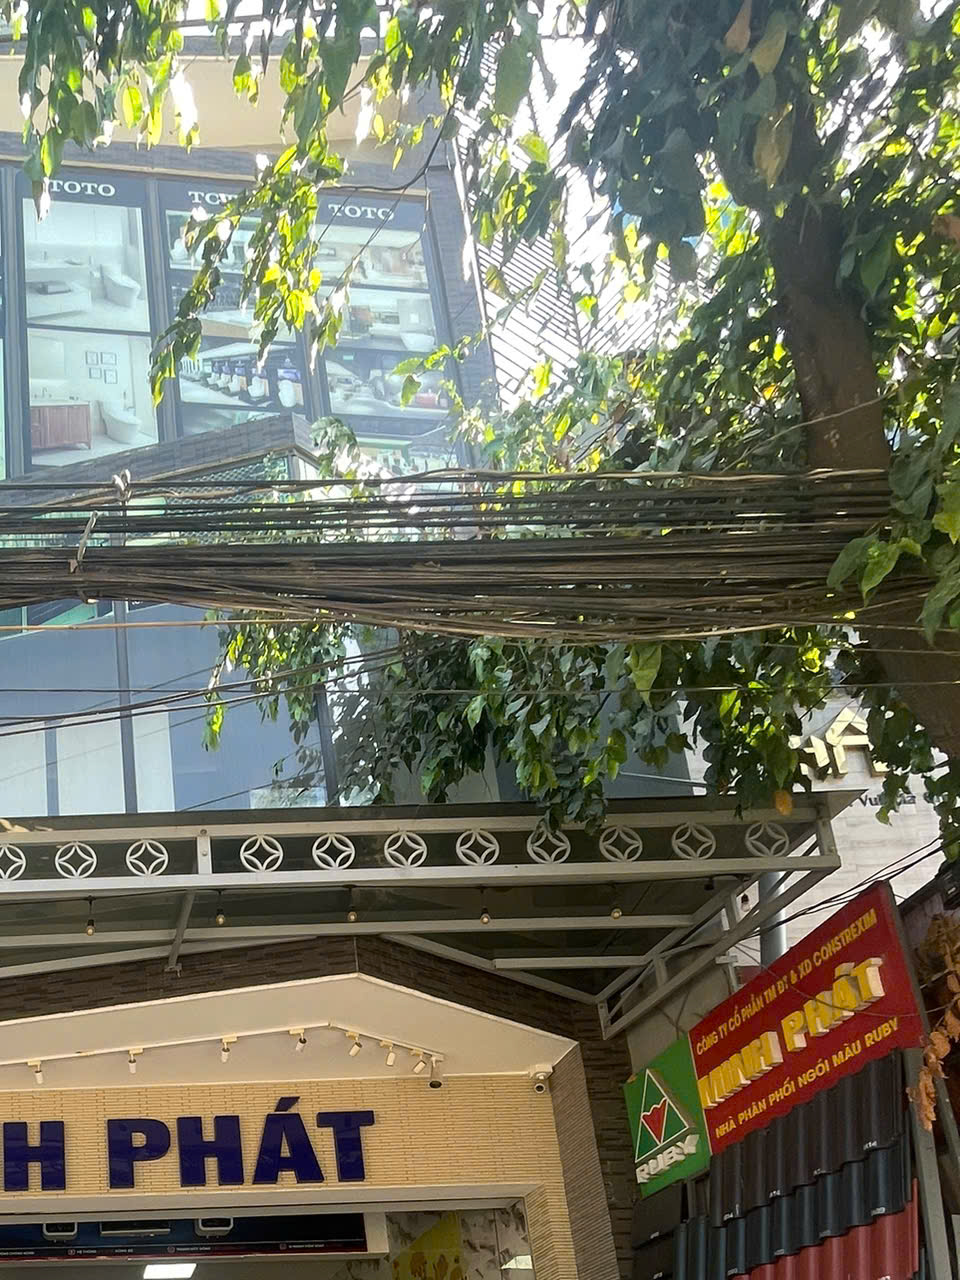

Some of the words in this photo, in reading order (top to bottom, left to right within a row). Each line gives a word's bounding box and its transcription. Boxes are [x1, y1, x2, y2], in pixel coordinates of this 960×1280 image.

[47, 178, 116, 198] TOTO
[327, 203, 396, 222] TOTO
[696, 1031, 719, 1056] CÔNG
[718, 1023, 728, 1040] TY
[728, 1006, 742, 1031] CỔ
[764, 986, 777, 1006] TM
[790, 972, 798, 985] &
[798, 960, 813, 981] XD
[812, 907, 878, 967] CONSTREXIM
[698, 1031, 784, 1110] MINH
[780, 957, 886, 1052] PHÁT
[716, 1115, 737, 1138] NHÀ
[738, 1098, 767, 1128] PHÂN
[768, 1077, 796, 1106] PHỐI
[798, 1058, 830, 1087] NGÓI
[832, 1040, 861, 1067] MÀU
[864, 1016, 899, 1047] RUBY
[106, 1096, 376, 1189] PHÁT
[635, 1133, 701, 1184] RUBY
